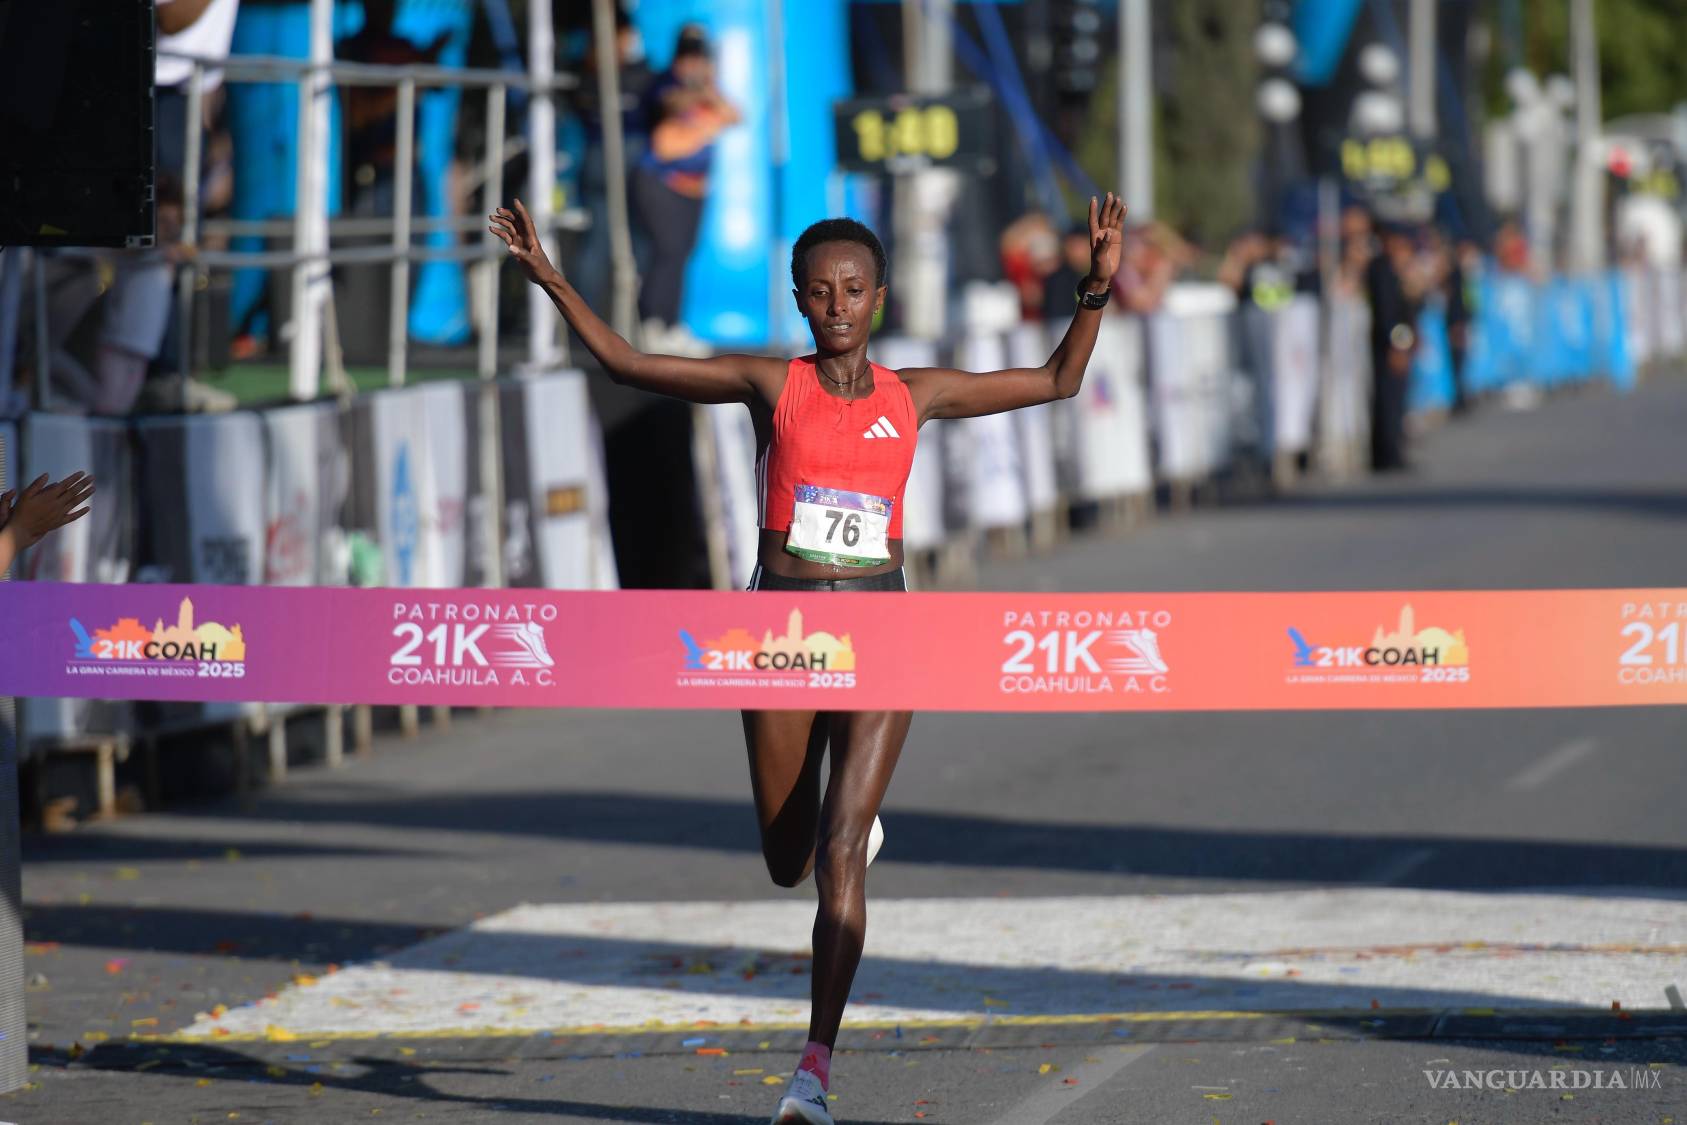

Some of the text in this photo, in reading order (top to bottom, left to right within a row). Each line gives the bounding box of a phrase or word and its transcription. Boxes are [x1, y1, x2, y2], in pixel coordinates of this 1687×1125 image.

[825, 510, 861, 547] 76
[393, 603, 558, 621] PATRONATO
[1004, 610, 1172, 628] PATRONATO
[390, 622, 490, 666] 21K
[1001, 630, 1103, 673] 21K
[1619, 621, 1687, 664] 21
[66, 666, 78, 674] LA
[80, 666, 104, 675] GRAN
[106, 667, 145, 676] CARRERA
[147, 667, 159, 676] DE
[197, 662, 245, 677] 2025
[388, 668, 556, 686] COAHUILA A. C.
[1421, 667, 1469, 683] 2025
[678, 678, 689, 686] LA
[691, 678, 716, 686] GRAN
[717, 678, 757, 687] CARRERA
[759, 678, 769, 687] DE
[808, 673, 856, 687] 2025
[1000, 675, 1113, 693] COAHUILA
